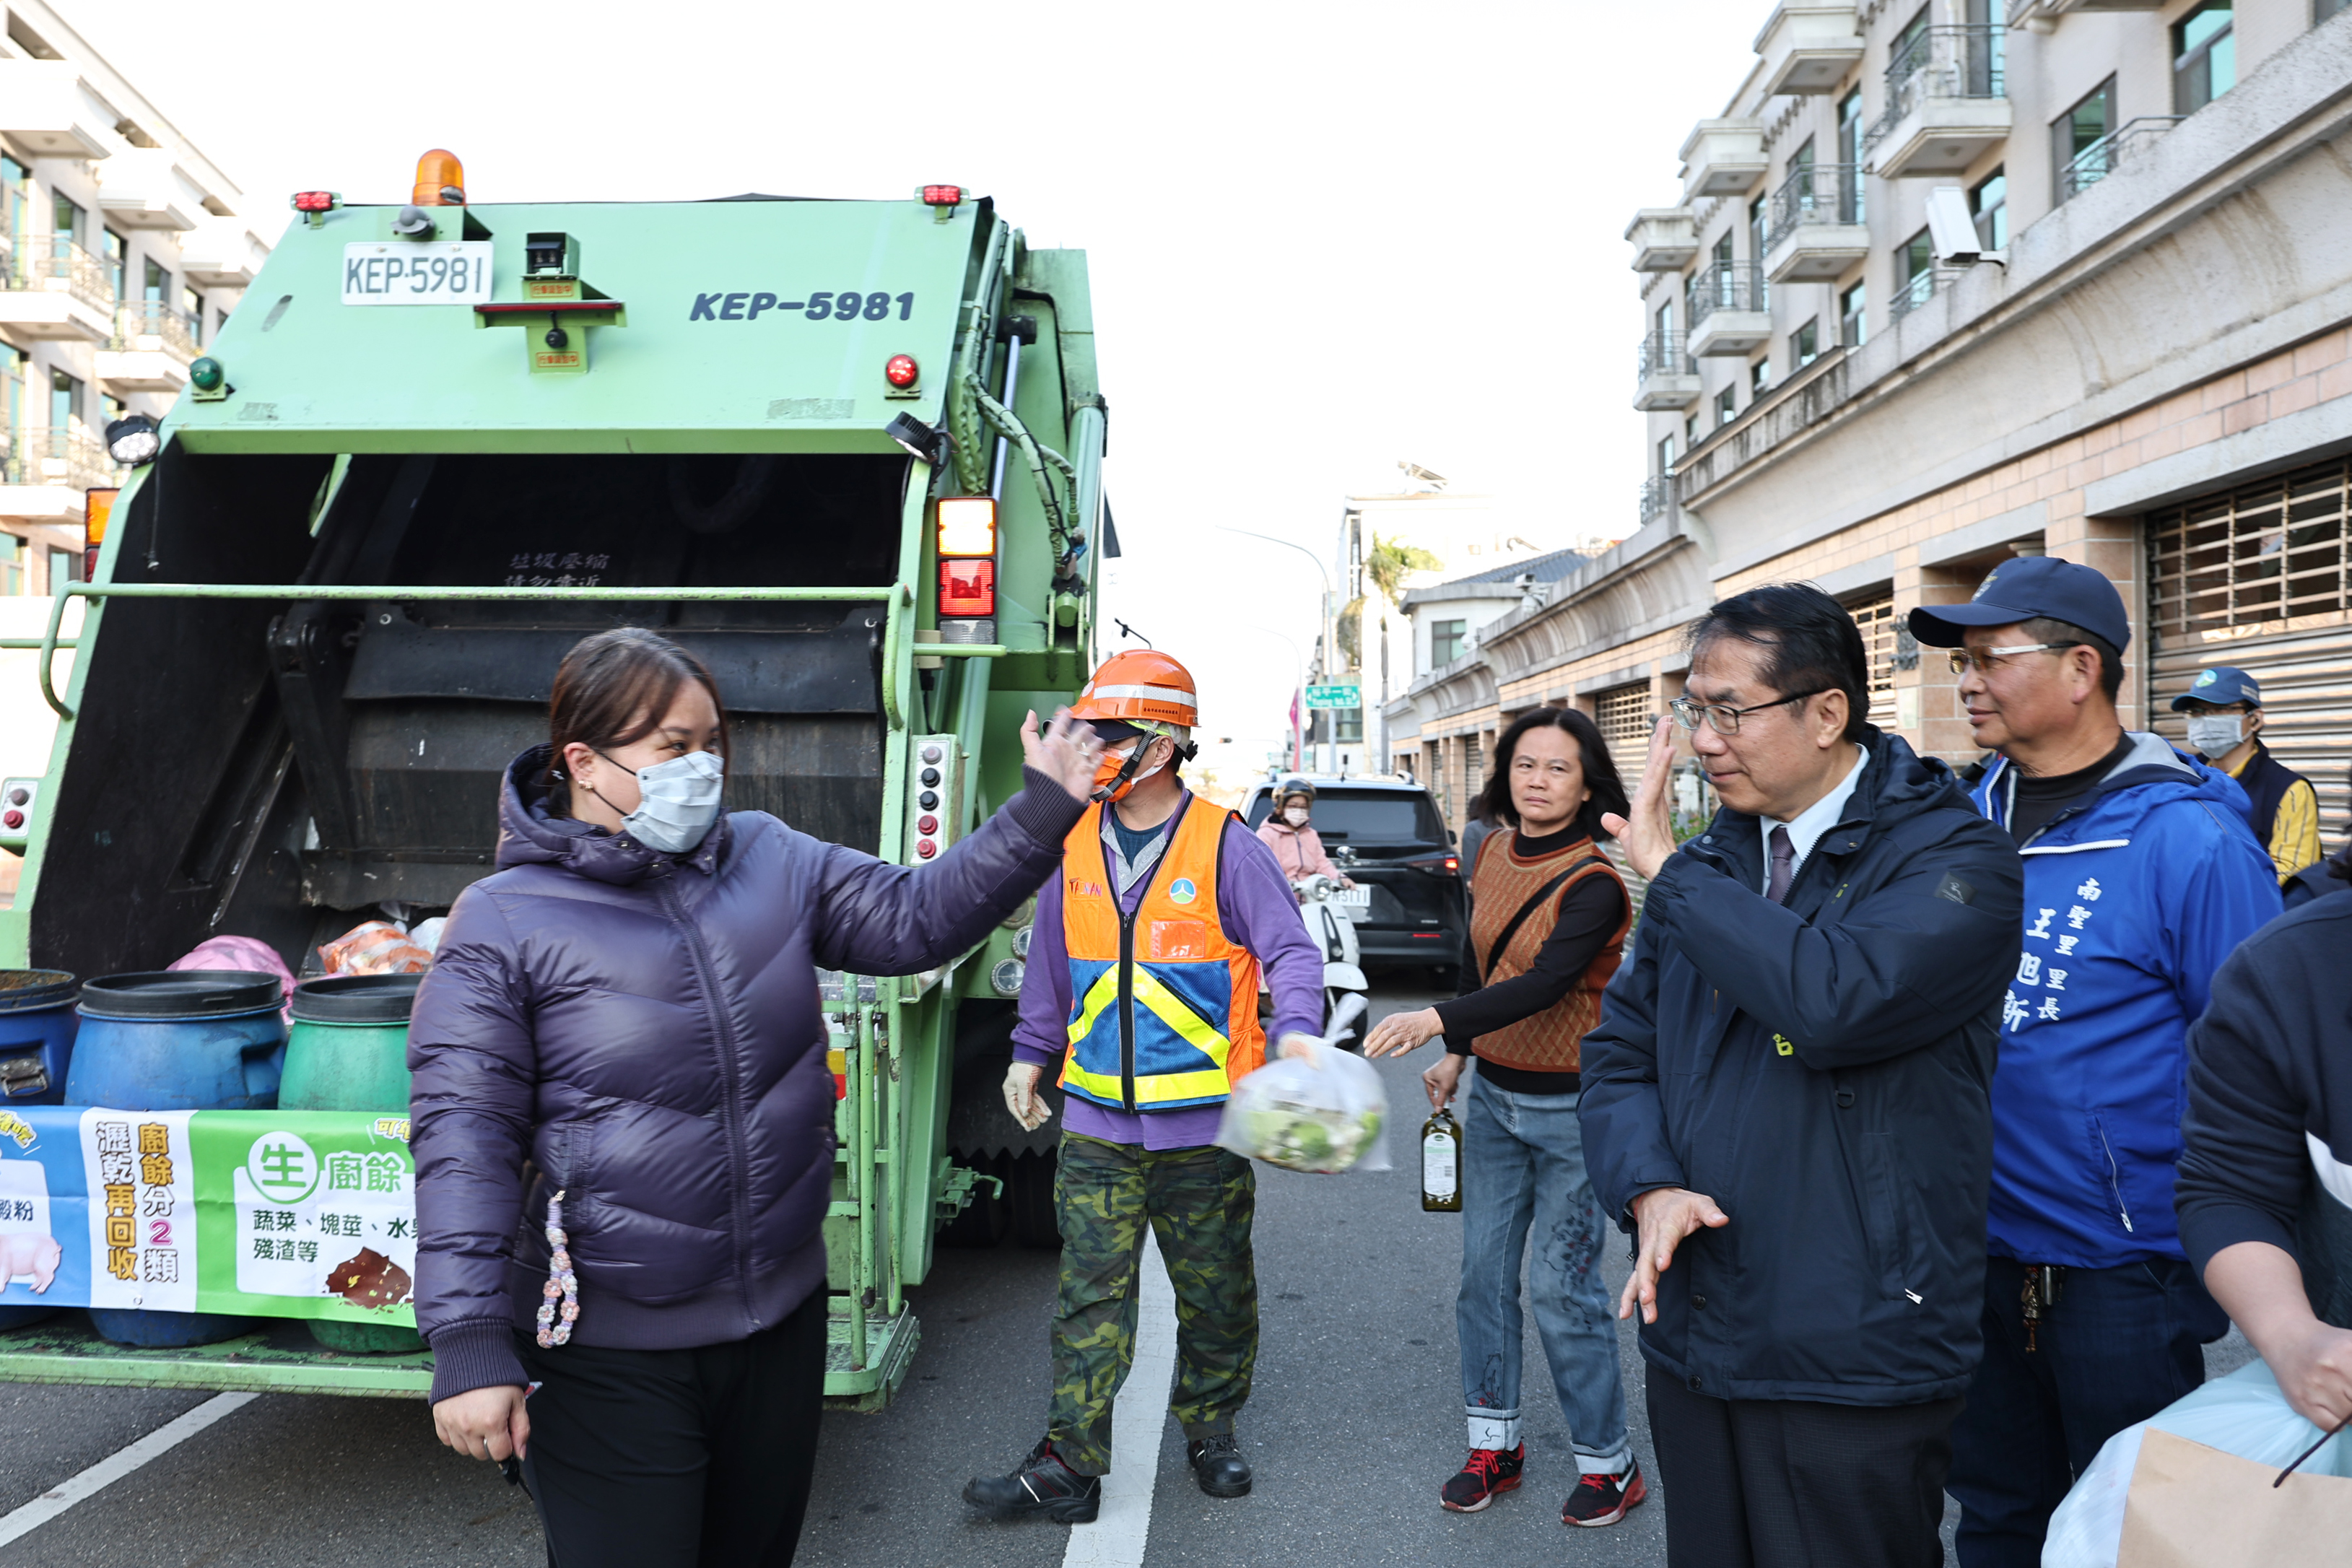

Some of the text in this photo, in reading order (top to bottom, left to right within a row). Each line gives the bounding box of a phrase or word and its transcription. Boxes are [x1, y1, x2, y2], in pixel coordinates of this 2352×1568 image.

[689, 292, 914, 321] KEP-5981
[509, 552, 610, 569] 垃圾壓縮
[2037, 877, 2102, 1022] 南聖里里長
[261, 1143, 401, 1193] 生 廚餘
[96, 1121, 139, 1281] 瀝乾再回收
[138, 1123, 179, 1283] 廚餘分2類
[253, 1237, 319, 1263] 殘渣等
